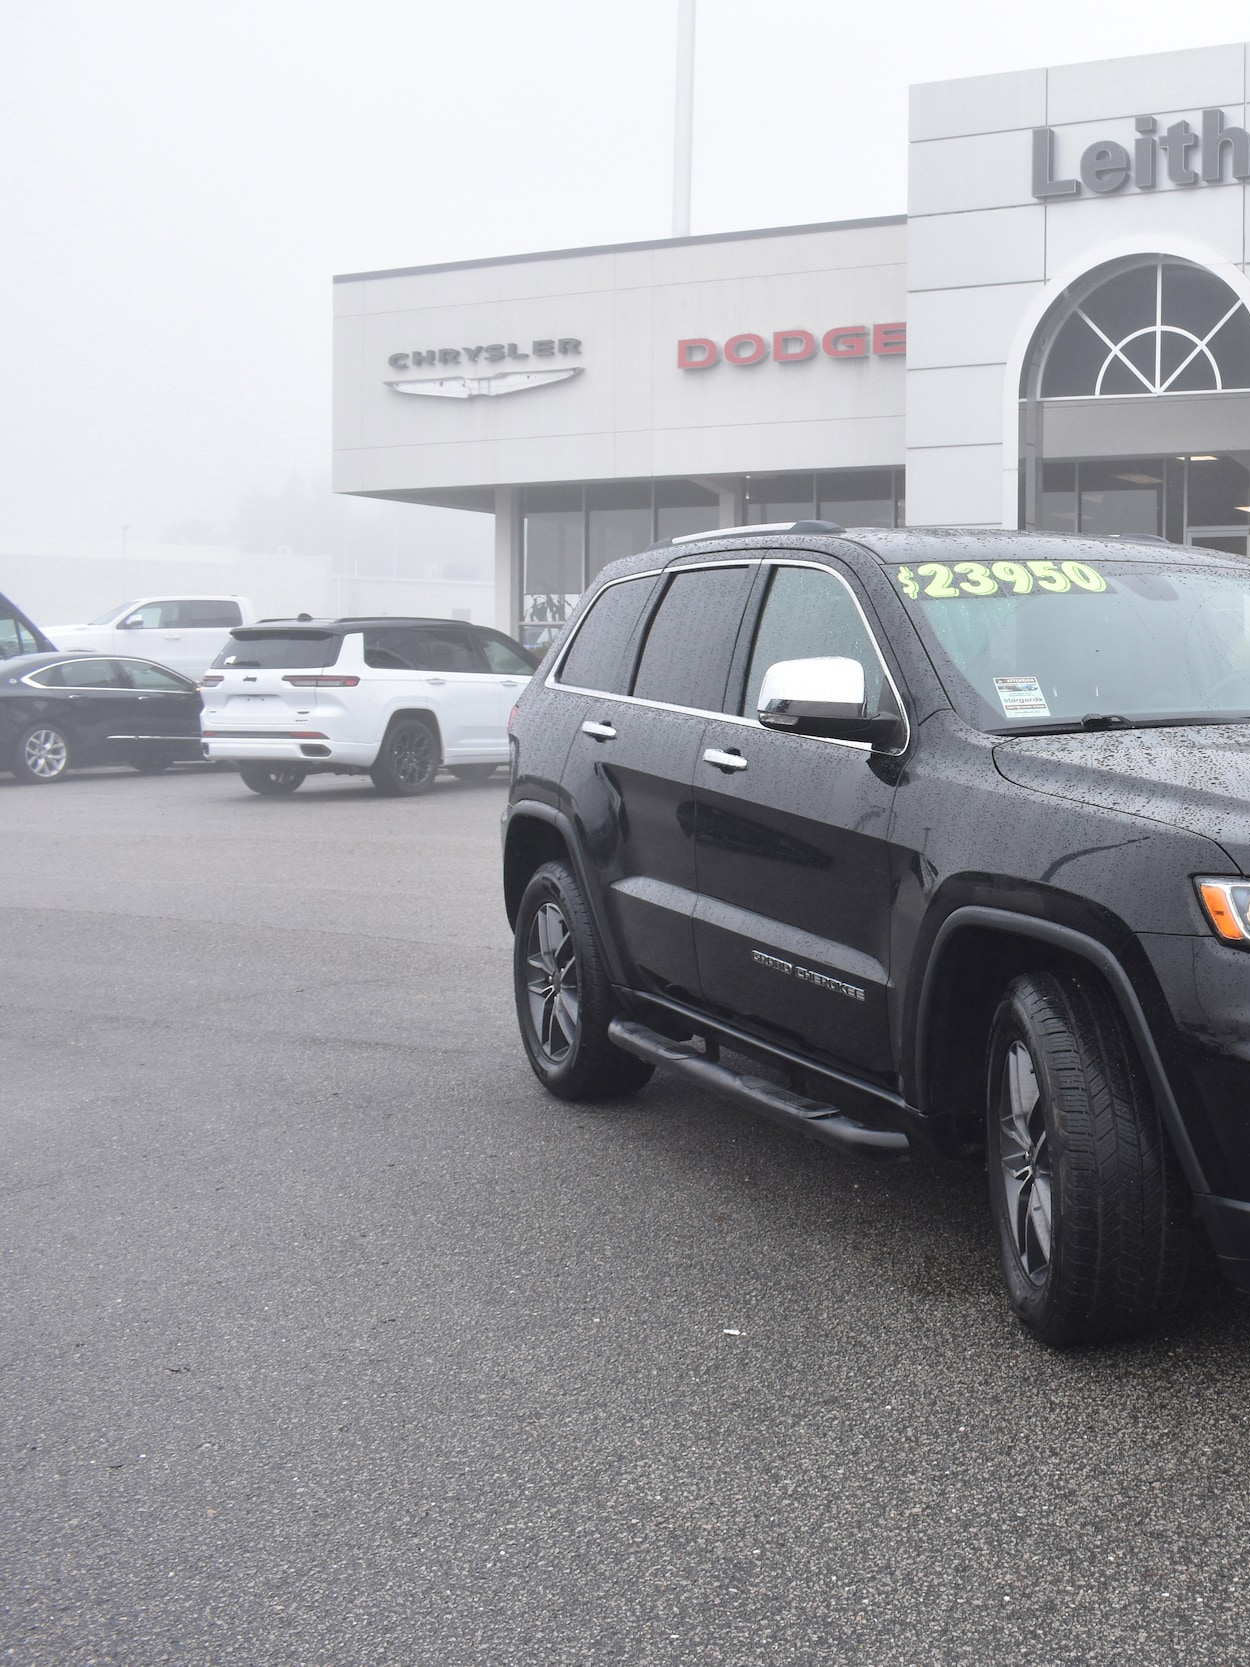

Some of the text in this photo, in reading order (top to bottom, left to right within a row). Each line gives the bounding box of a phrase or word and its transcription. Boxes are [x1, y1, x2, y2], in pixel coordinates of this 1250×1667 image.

[388, 338, 582, 370] CHRYSLER
[677, 322, 907, 369] DODGE
[898, 561, 1107, 599] $23950
[752, 949, 866, 1001] GRAND CHEROKEE
